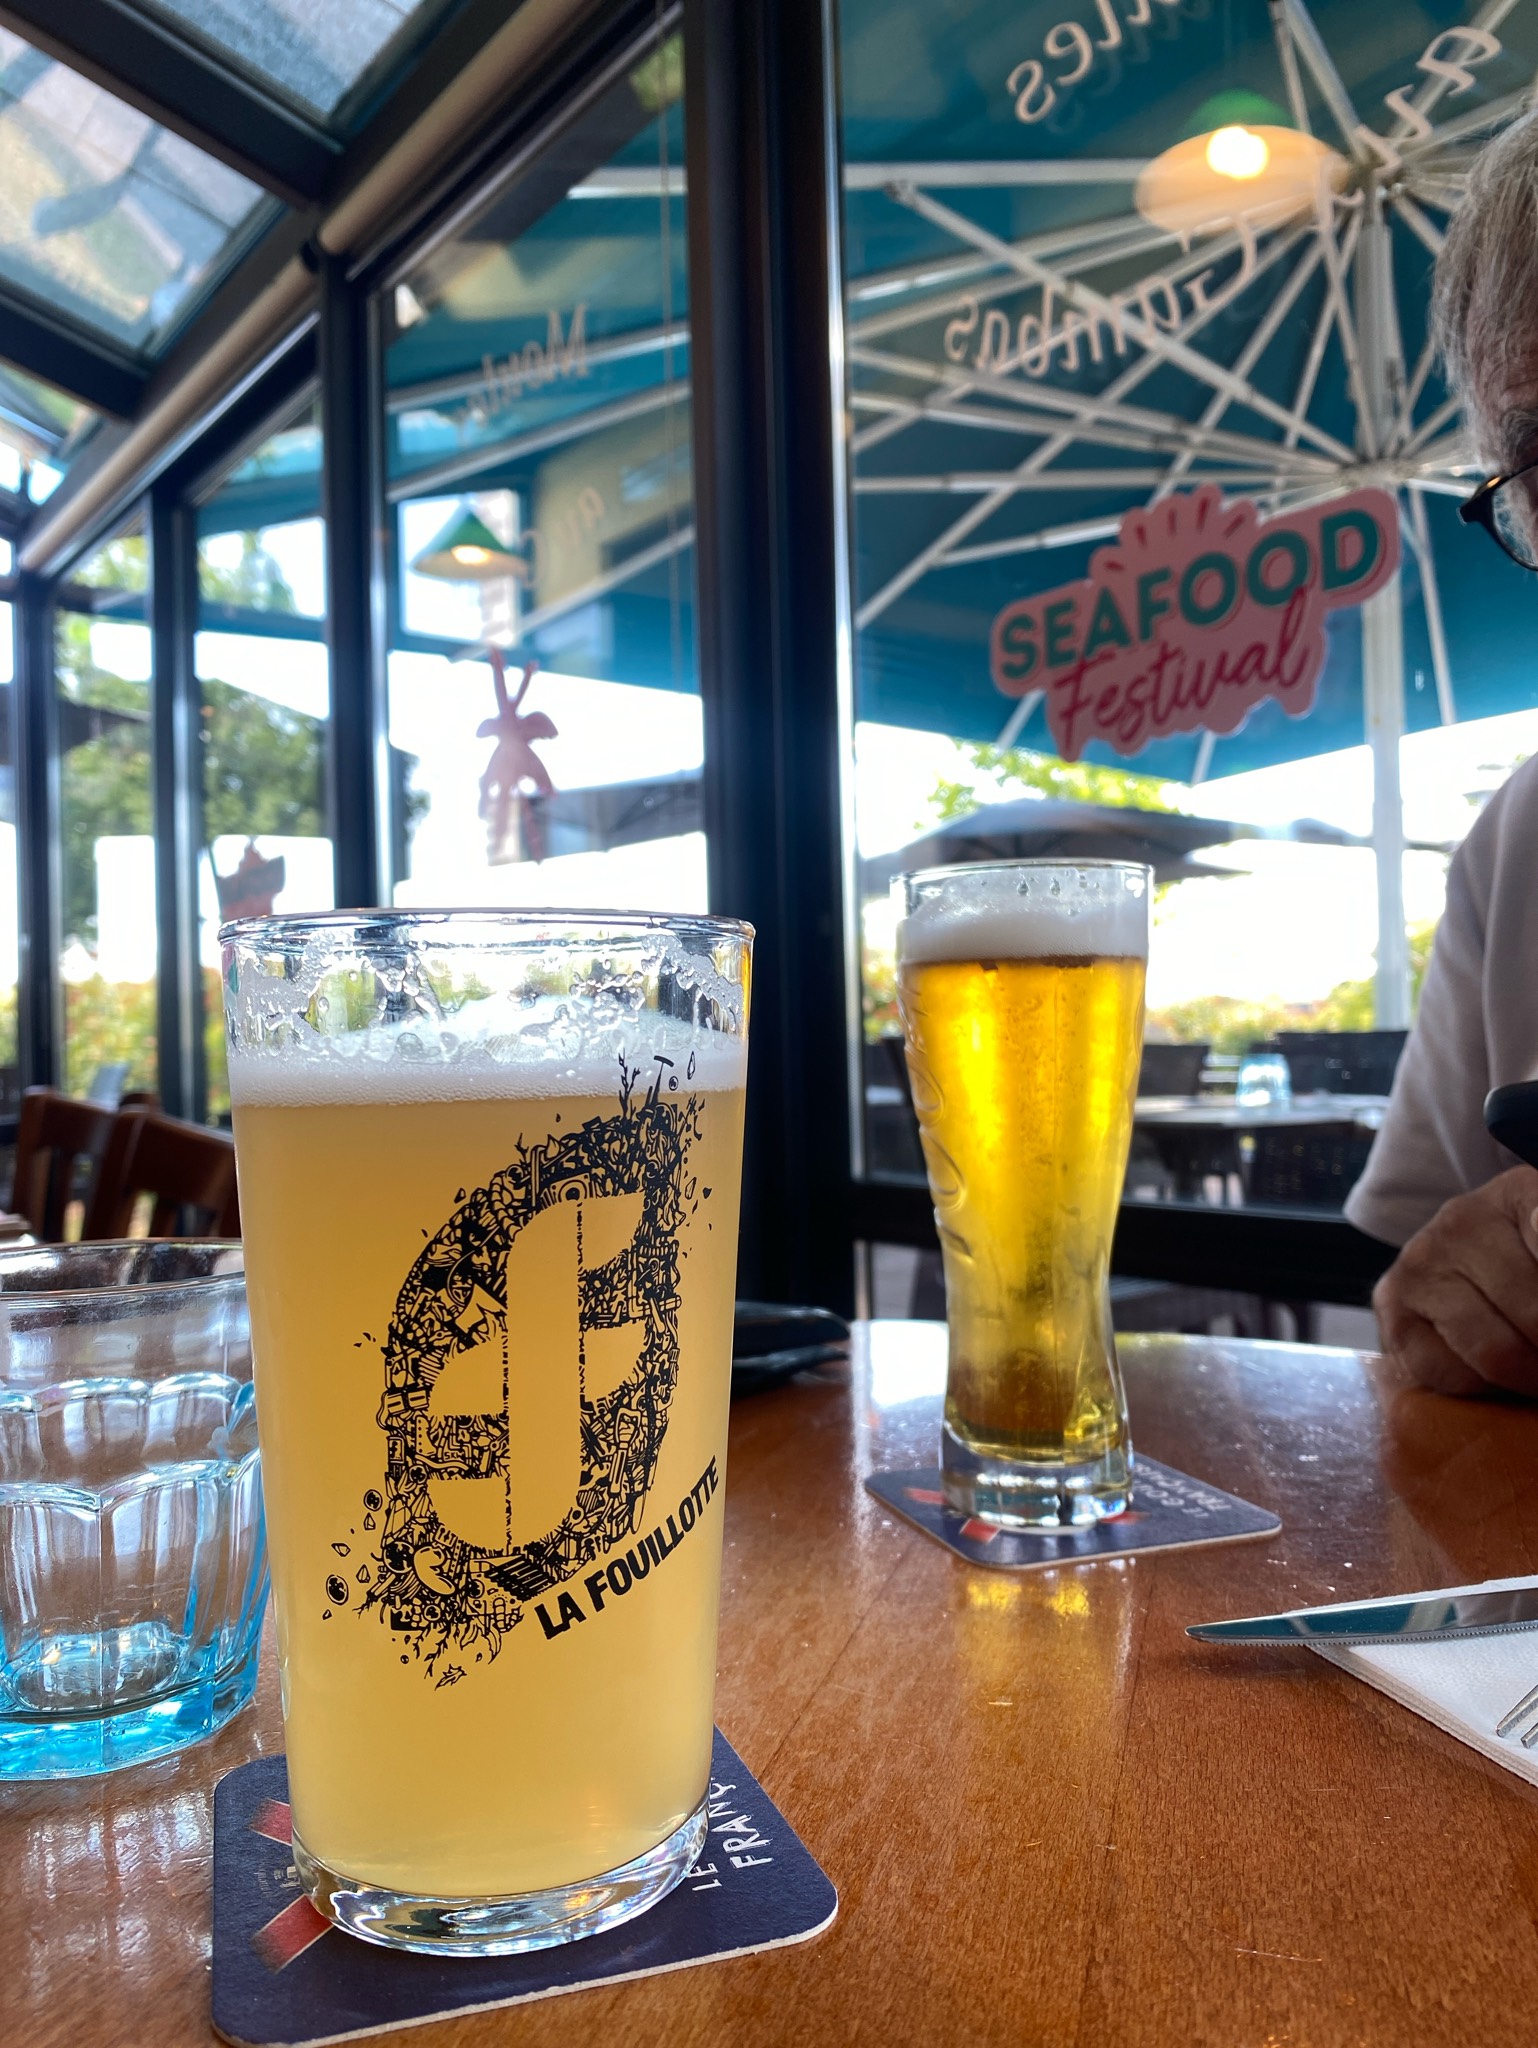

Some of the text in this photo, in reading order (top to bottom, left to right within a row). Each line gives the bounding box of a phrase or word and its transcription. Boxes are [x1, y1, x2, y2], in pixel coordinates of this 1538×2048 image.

[1000, 508, 1380, 681] SEAFOOD
[1053, 584, 1311, 756] Festival
[534, 1455, 719, 1640] LA FOUILLOTTE
